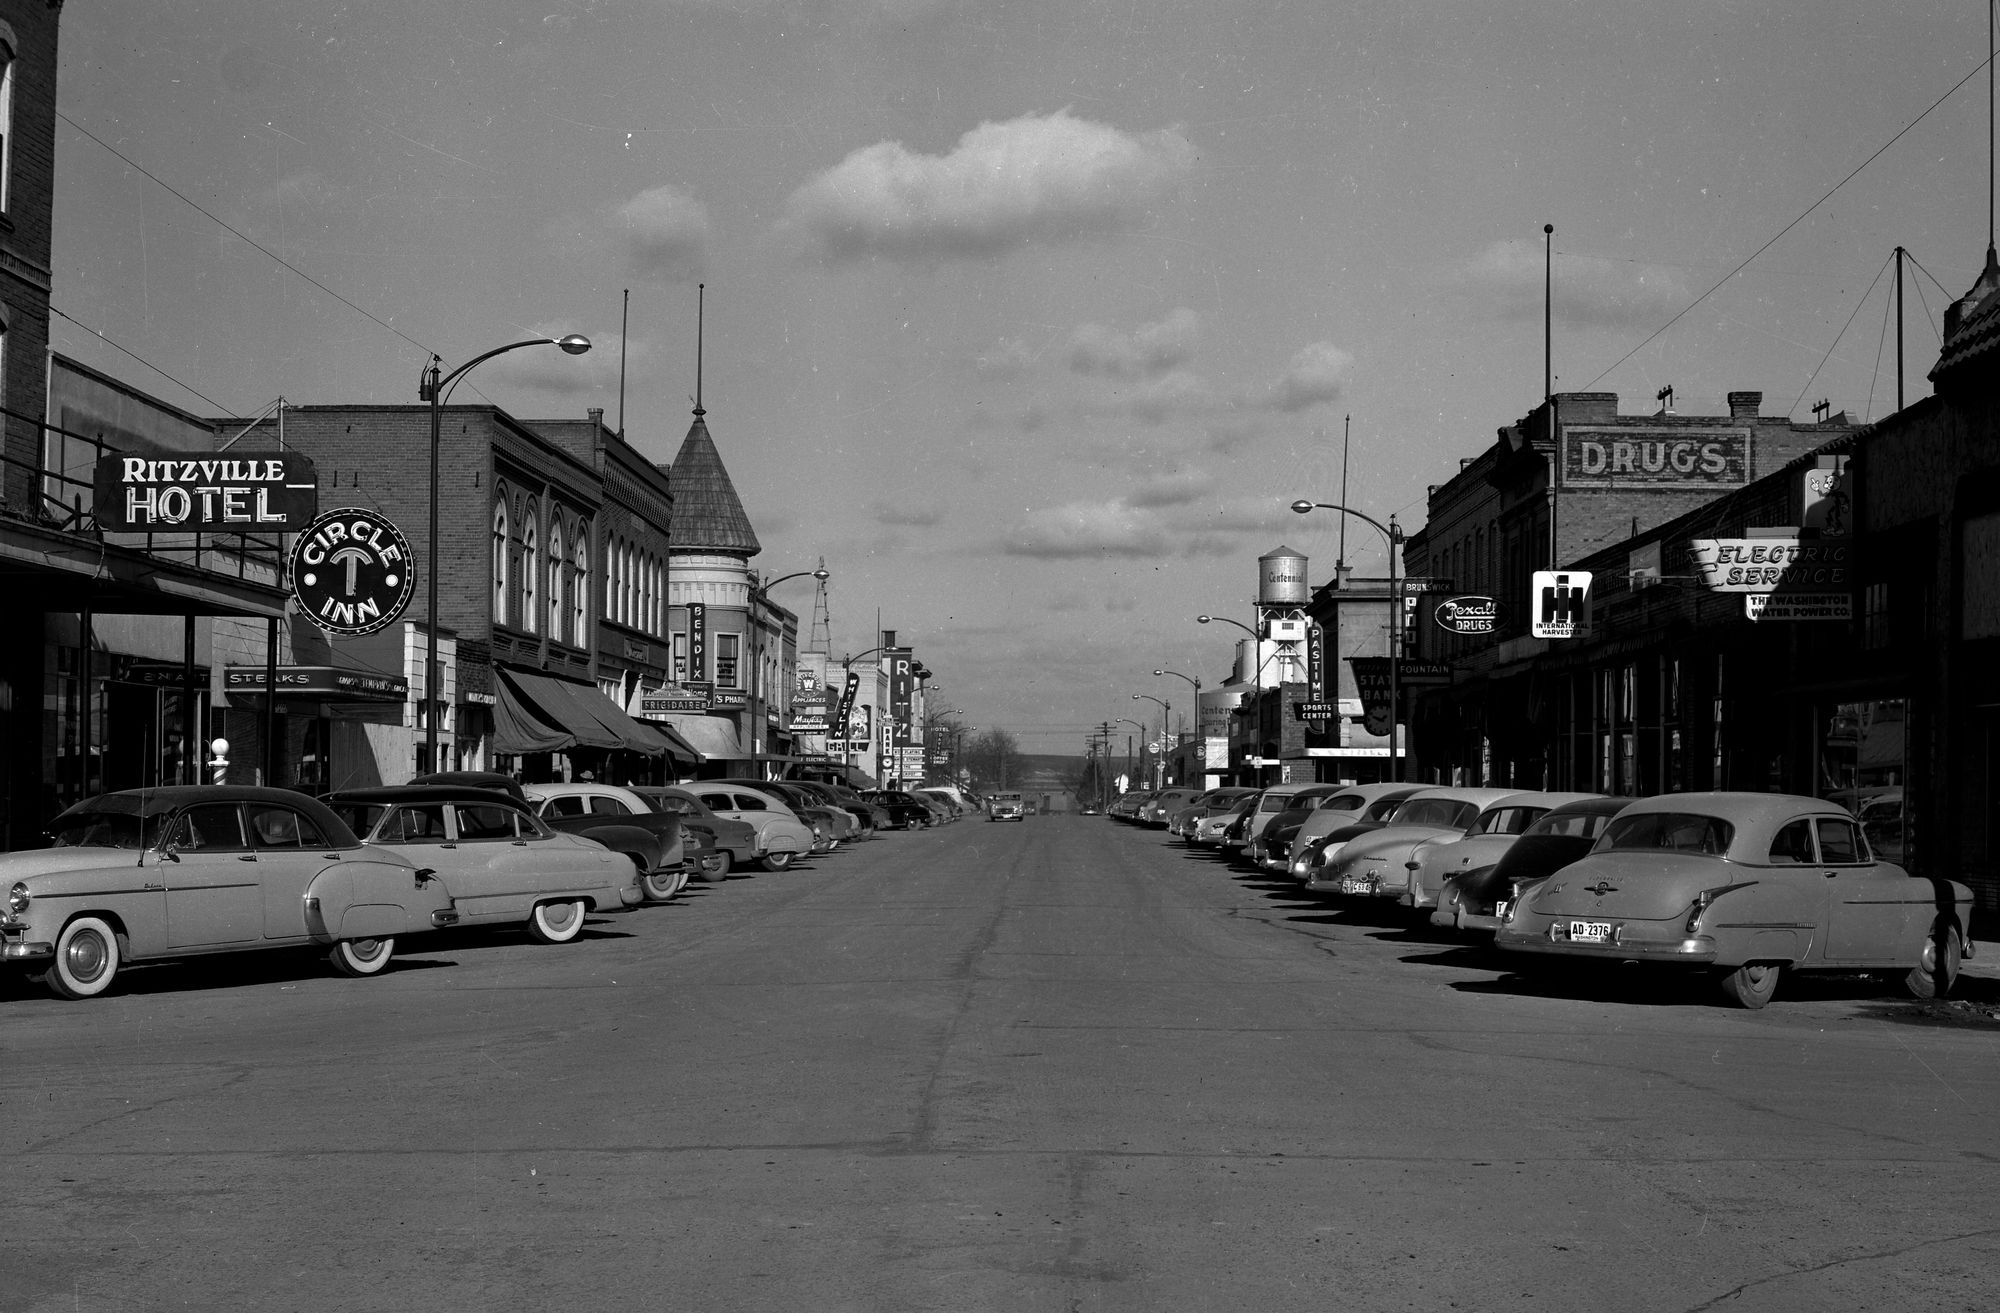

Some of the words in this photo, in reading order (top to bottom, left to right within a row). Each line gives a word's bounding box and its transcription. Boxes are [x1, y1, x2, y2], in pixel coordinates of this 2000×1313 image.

[1581, 441, 1728, 475] DRUGS
[122, 457, 285, 483] RITZVILLE
[126, 486, 287, 525] HOTEL
[303, 520, 402, 569] CIRCLE
[1718, 546, 1847, 564] ELECTRIC
[330, 547, 374, 596] T
[1268, 571, 1304, 583] Centennial
[1726, 567, 1846, 585] SERVICE
[1406, 583, 1450, 592] BRUNSWICK
[1751, 596, 1772, 605] THE
[1775, 596, 1848, 605] WASHINGTON
[320, 597, 381, 625] INN
[1445, 601, 1497, 621] Rexall
[1752, 607, 1790, 617] WATER
[1794, 607, 1832, 617] POWER
[1834, 607, 1849, 617] CO.
[1405, 596, 1417, 661] POOL
[1455, 619, 1492, 631] DRUGS
[693, 606, 702, 679] BENDIX
[1311, 629, 1321, 701] PASTIME
[1400, 665, 1449, 674] FOUNTAIN
[644, 700, 701, 710] FRIGIDAIRE
[896, 660, 909, 738] RITZ
[1302, 704, 1332, 712] SPORTS
[793, 715, 824, 726] Maytag
[1302, 712, 1332, 720] CENTER
[828, 742, 863, 751] GRILL
